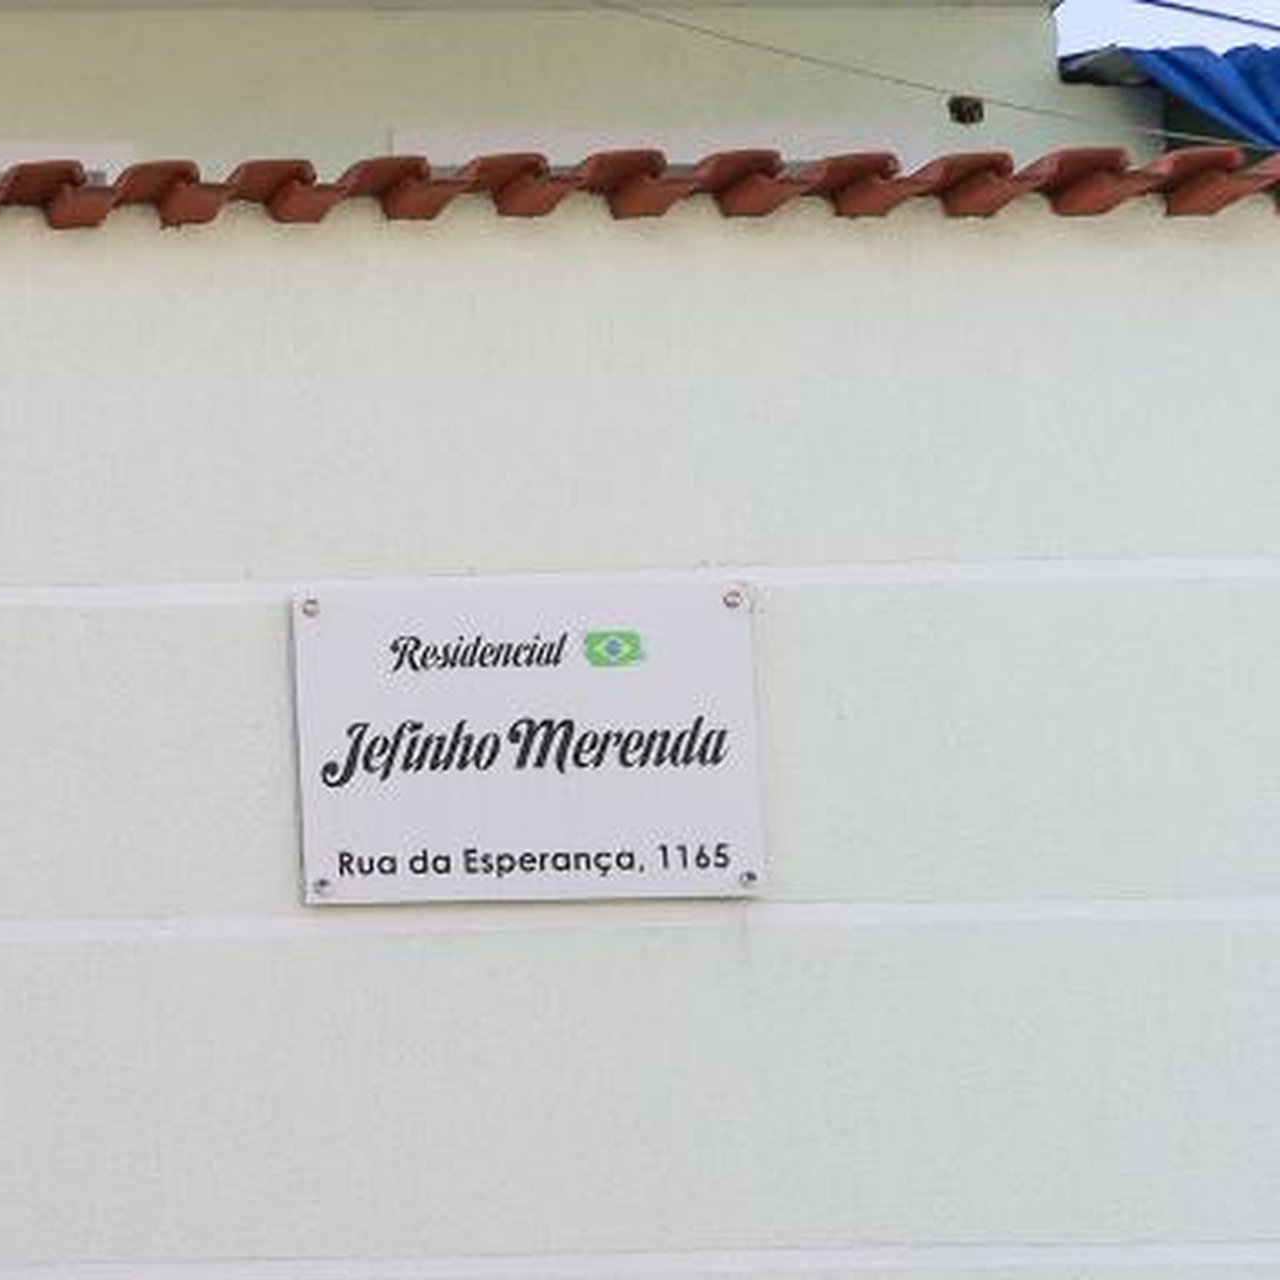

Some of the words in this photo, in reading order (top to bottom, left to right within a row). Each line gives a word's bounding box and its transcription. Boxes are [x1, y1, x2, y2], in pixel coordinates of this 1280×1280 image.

[389, 633, 568, 672] Residencial
[321, 720, 502, 788] Jefinho
[506, 716, 730, 774] Merenda
[338, 852, 397, 876] Rua
[408, 850, 452, 875] da
[464, 846, 644, 878] Esperança,
[658, 844, 732, 871] 1165
